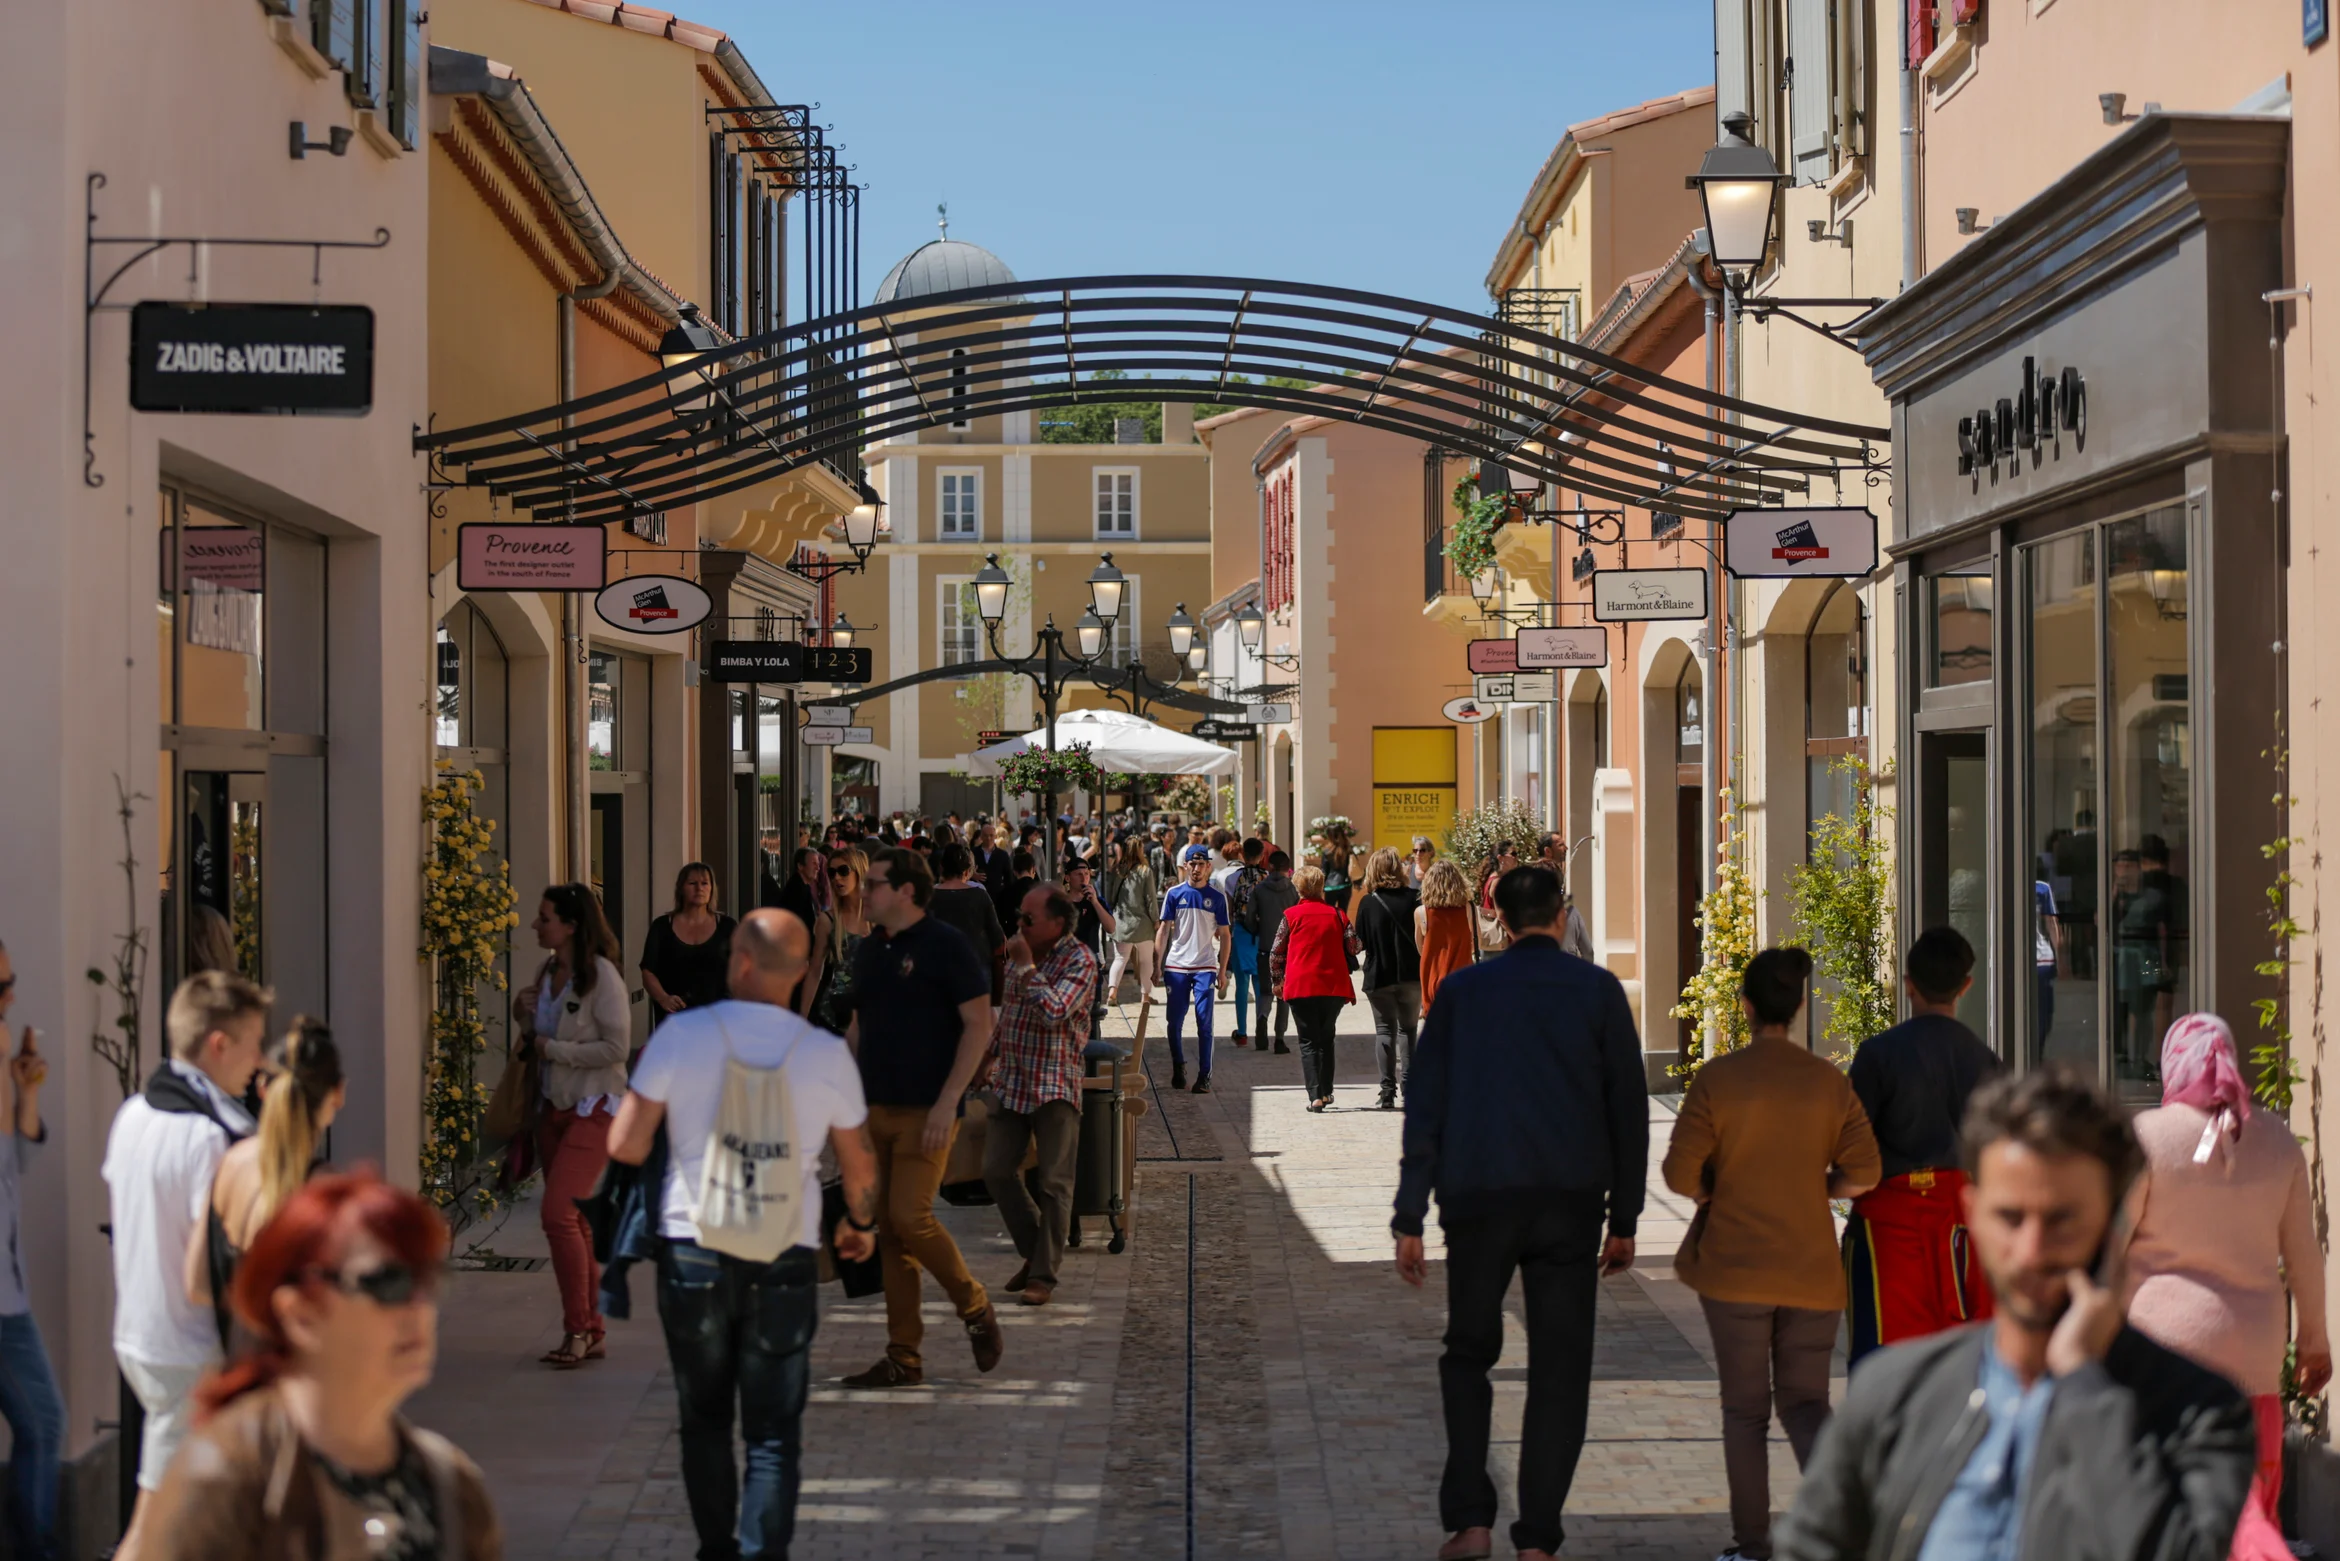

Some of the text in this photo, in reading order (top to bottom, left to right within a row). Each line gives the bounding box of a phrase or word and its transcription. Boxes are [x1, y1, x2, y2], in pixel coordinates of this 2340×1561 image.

[156, 342, 346, 375] ZADIG&VOLTAIRE
[1958, 356, 2080, 476] sandro
[1777, 523, 1810, 540] McArthur
[486, 534, 575, 555] Provence
[1780, 536, 1798, 547] Glen
[1784, 549, 1817, 557] Provence
[484, 560, 575, 570] The first designer outlet
[535, 570, 544, 578] of
[635, 588, 663, 602] McArthur
[637, 599, 652, 608] Glen
[1606, 600, 1694, 611] Harmont&Blaine
[639, 609, 668, 617] Provence
[1486, 648, 1516, 657] Proven
[1526, 652, 1597, 660] Harmont&Blaine
[720, 657, 790, 667] BIMBA Y LOLA
[1382, 793, 1440, 805] ENRICH
[1403, 805, 1440, 813] EXPLOIT
